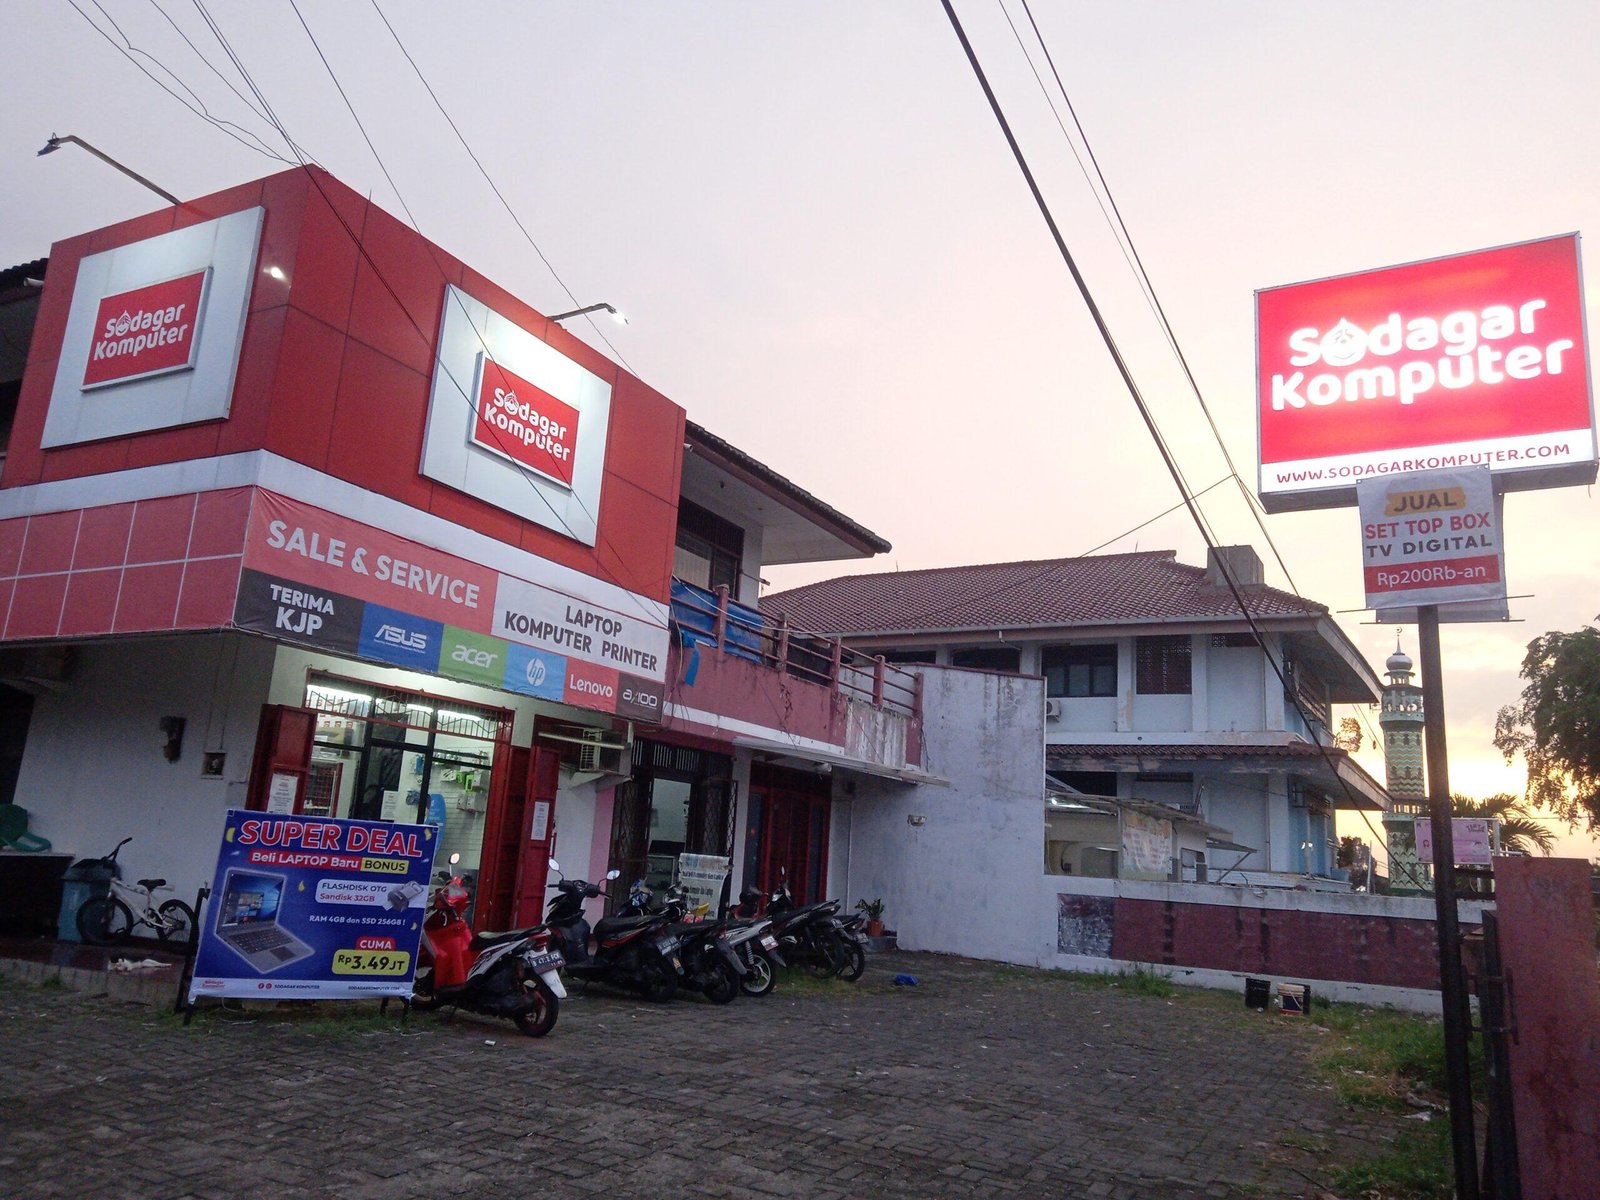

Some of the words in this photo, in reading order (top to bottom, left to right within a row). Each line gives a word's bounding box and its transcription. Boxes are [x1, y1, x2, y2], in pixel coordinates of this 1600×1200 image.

[104, 304, 186, 338] Sodagar
[1288, 299, 1546, 367] Sodagar
[93, 324, 188, 360] Komputer
[1270, 339, 1574, 411] Komputer
[493, 387, 567, 440] Sodagar
[484, 402, 571, 461] Komputer
[1276, 443, 1570, 483] WWW.SODAGARKOMPUTER.COM
[1393, 491, 1457, 512] JUAL
[1365, 522, 1400, 539] SET
[1405, 517, 1443, 536] TOP
[1450, 511, 1491, 531] BOX
[1366, 543, 1393, 558] TV
[1402, 534, 1493, 555] DIGITAL
[266, 519, 347, 568] SALE
[351, 547, 370, 576] &
[374, 554, 481, 609] SERVICE
[1377, 565, 1486, 588] Rp200Rb-an
[270, 583, 335, 616] TERIMA
[275, 606, 323, 636] KJP
[565, 605, 623, 638] LAPTOP
[374, 624, 427, 650] ASUS
[504, 610, 592, 654] KOMPUTER
[601, 640, 657, 673] PRINTER
[451, 644, 498, 669] acer
[527, 658, 545, 686] hp
[570, 673, 613, 698] Lenovo
[237, 820, 342, 850] SUPER
[346, 826, 423, 858] DEAL
[251, 852, 277, 864] Beli
[279, 854, 328, 866] LAPTOP
[331, 857, 359, 869] Baru
[364, 859, 406, 872] BONUS
[320, 892, 352, 901] Sandisk
[321, 882, 369, 892] FLASHDISK
[370, 885, 388, 893] OTG
[328, 915, 345, 923] 4GB
[361, 917, 377, 925] SSD
[377, 918, 402, 926] 256GB
[359, 939, 392, 950] CUMA
